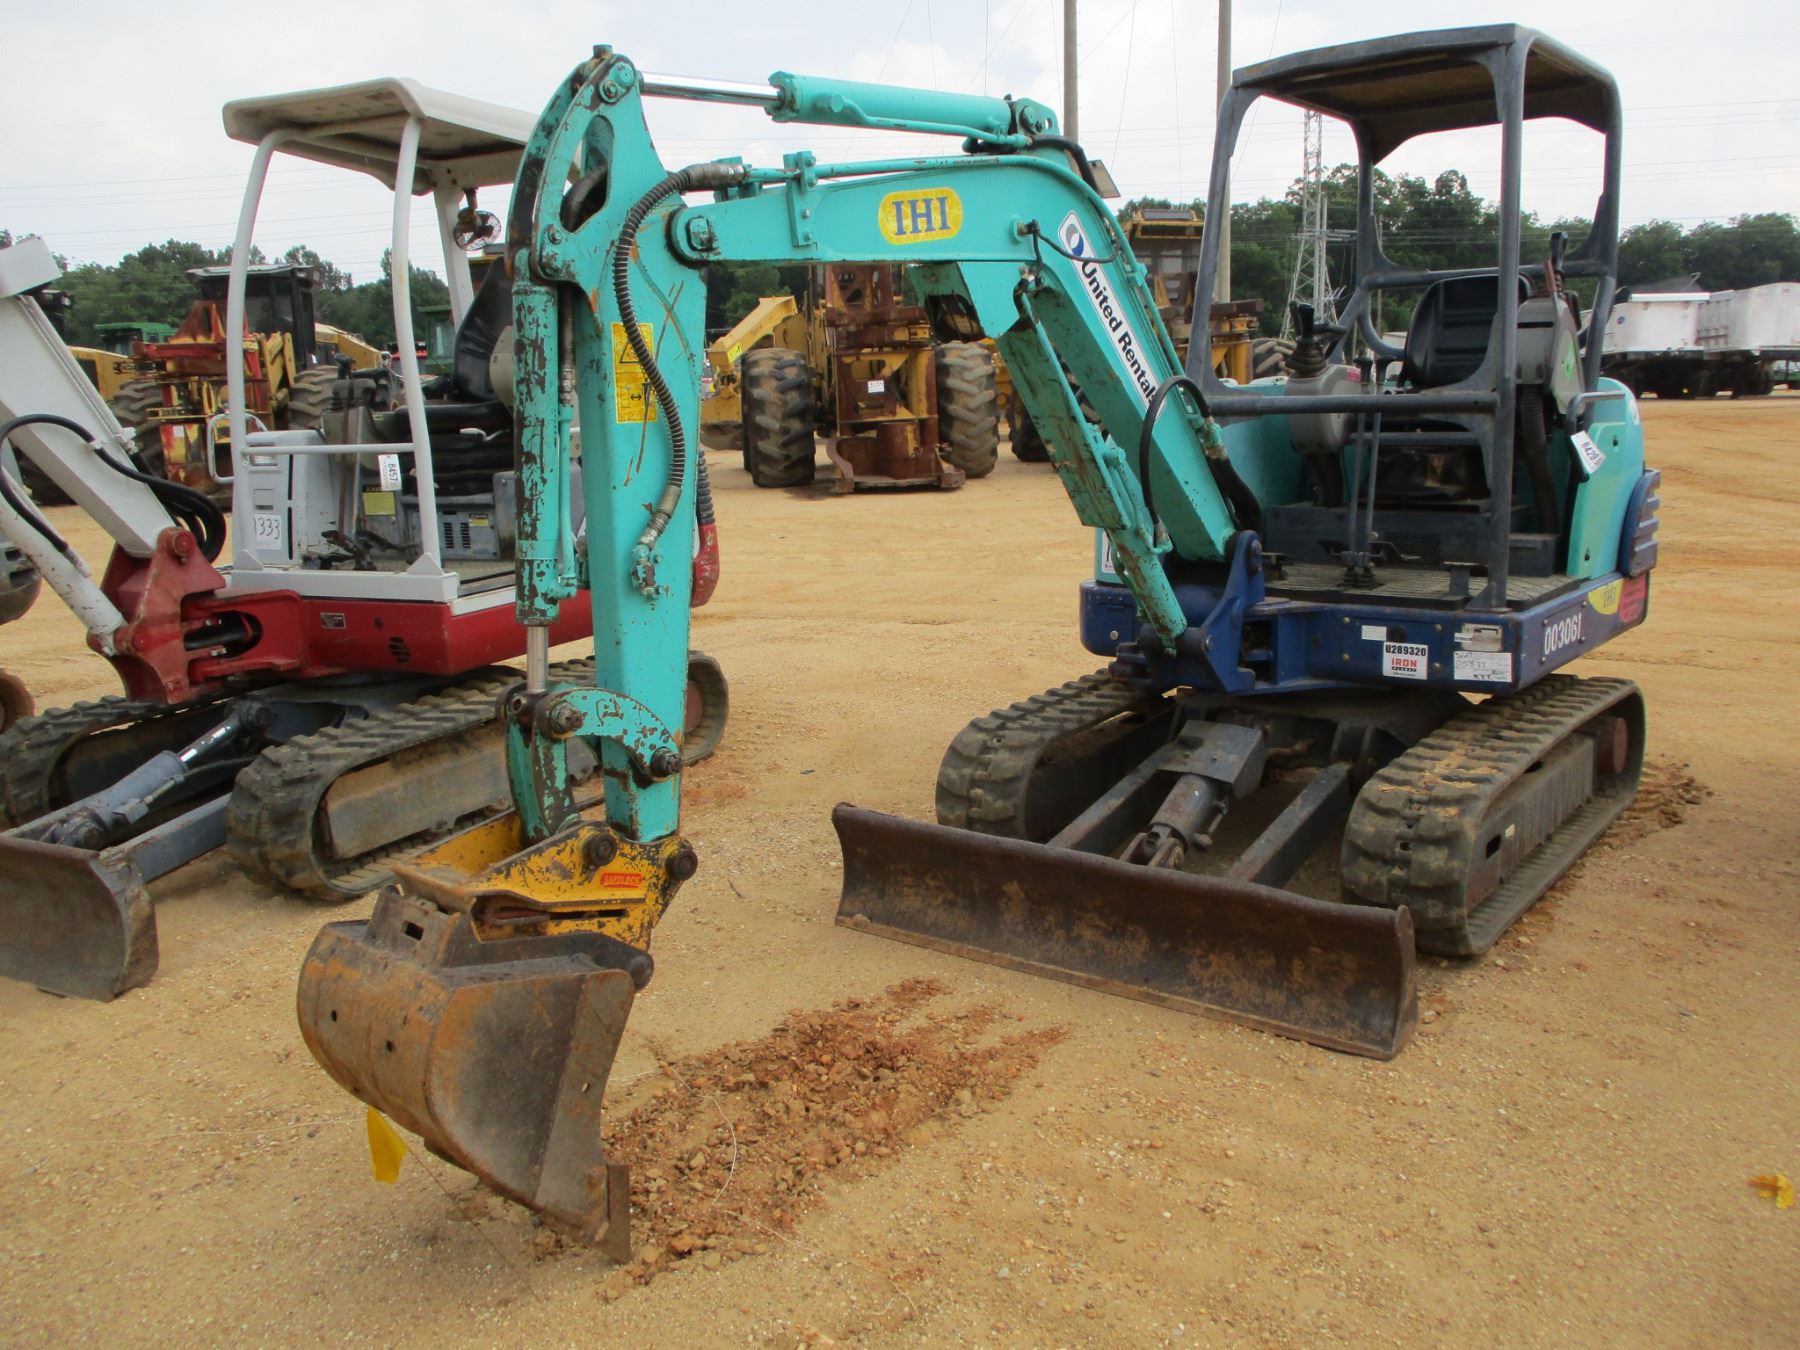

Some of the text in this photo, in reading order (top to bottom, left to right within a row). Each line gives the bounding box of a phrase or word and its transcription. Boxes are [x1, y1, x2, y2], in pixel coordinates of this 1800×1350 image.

[892, 196, 951, 236] IHI
[1081, 257, 1123, 334] United
[1385, 644, 1427, 657] U289320
[1544, 612, 1583, 655] 003061
[1391, 657, 1417, 668] IRON
